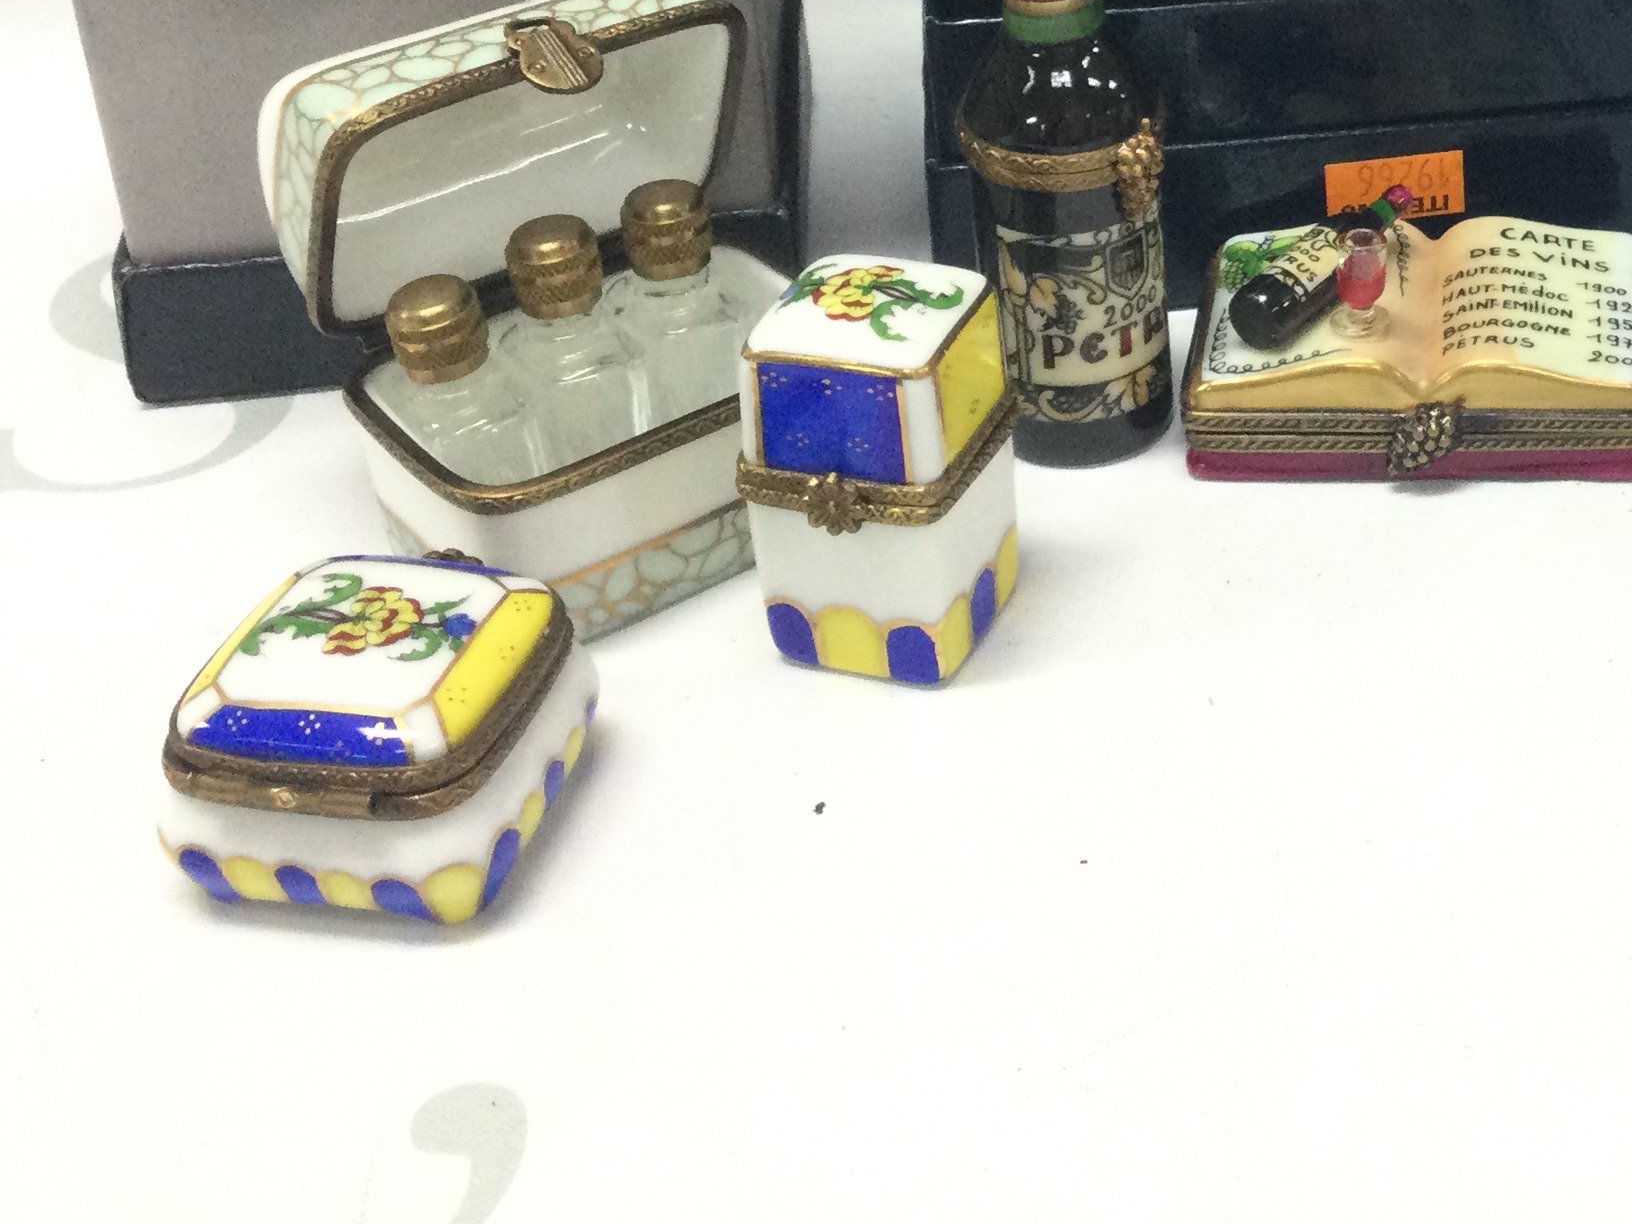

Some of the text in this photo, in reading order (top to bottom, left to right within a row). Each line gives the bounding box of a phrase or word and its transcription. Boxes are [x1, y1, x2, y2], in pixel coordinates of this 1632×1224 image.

[1469, 246, 1521, 260] DES
[1499, 226, 1597, 253] CARTE
[1442, 265, 1628, 297] SAUTERNES 1900
[1102, 284, 1158, 329] 2000
[1442, 317, 1572, 341] BOURGOGNE
